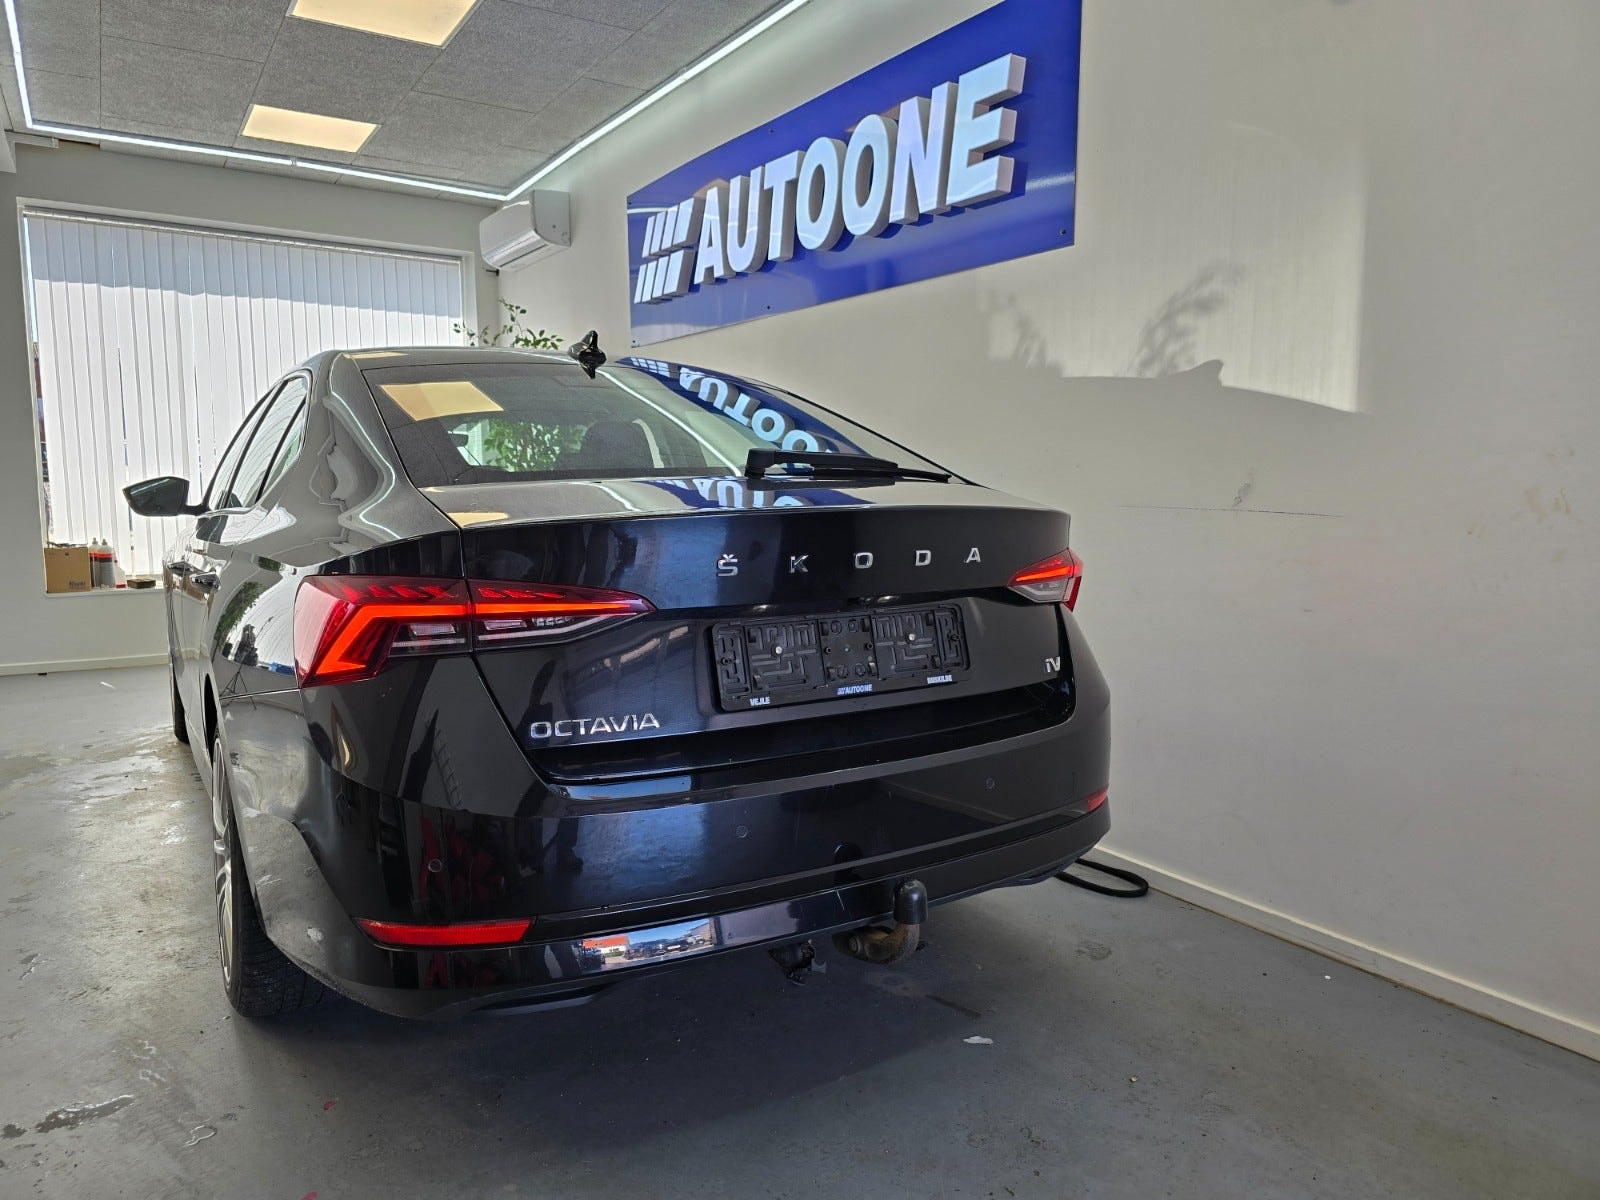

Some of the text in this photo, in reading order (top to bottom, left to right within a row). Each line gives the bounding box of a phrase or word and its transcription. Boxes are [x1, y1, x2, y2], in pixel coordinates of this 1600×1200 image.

[694, 52, 1026, 285] AUTOONE
[717, 547, 982, 577] ŠKODA
[749, 696, 771, 707] VEJLE
[845, 683, 873, 695] AUTOONE
[530, 713, 661, 739] OCTAVIA
